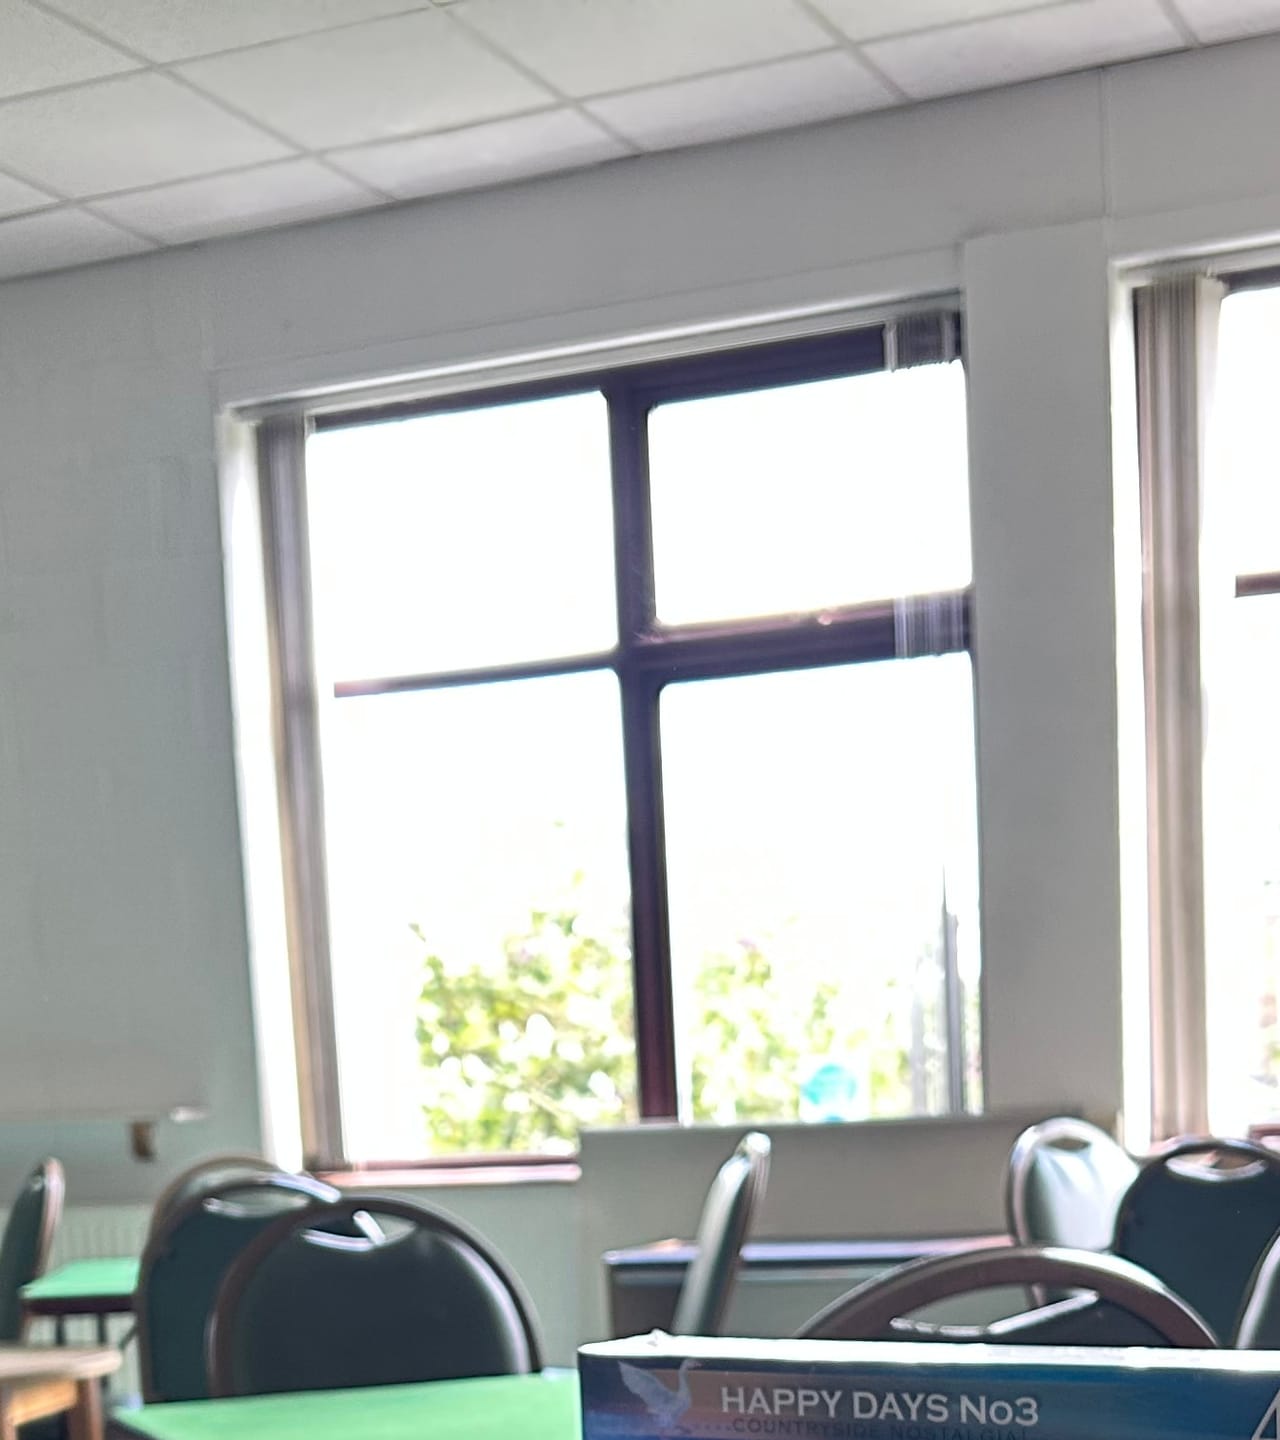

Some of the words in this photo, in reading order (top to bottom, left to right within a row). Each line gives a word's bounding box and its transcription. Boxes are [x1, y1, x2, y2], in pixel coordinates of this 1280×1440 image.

[721, 1386, 842, 1418] HAPPY
[853, 1390, 949, 1423] DAYS
[960, 1394, 1039, 1426] No3
